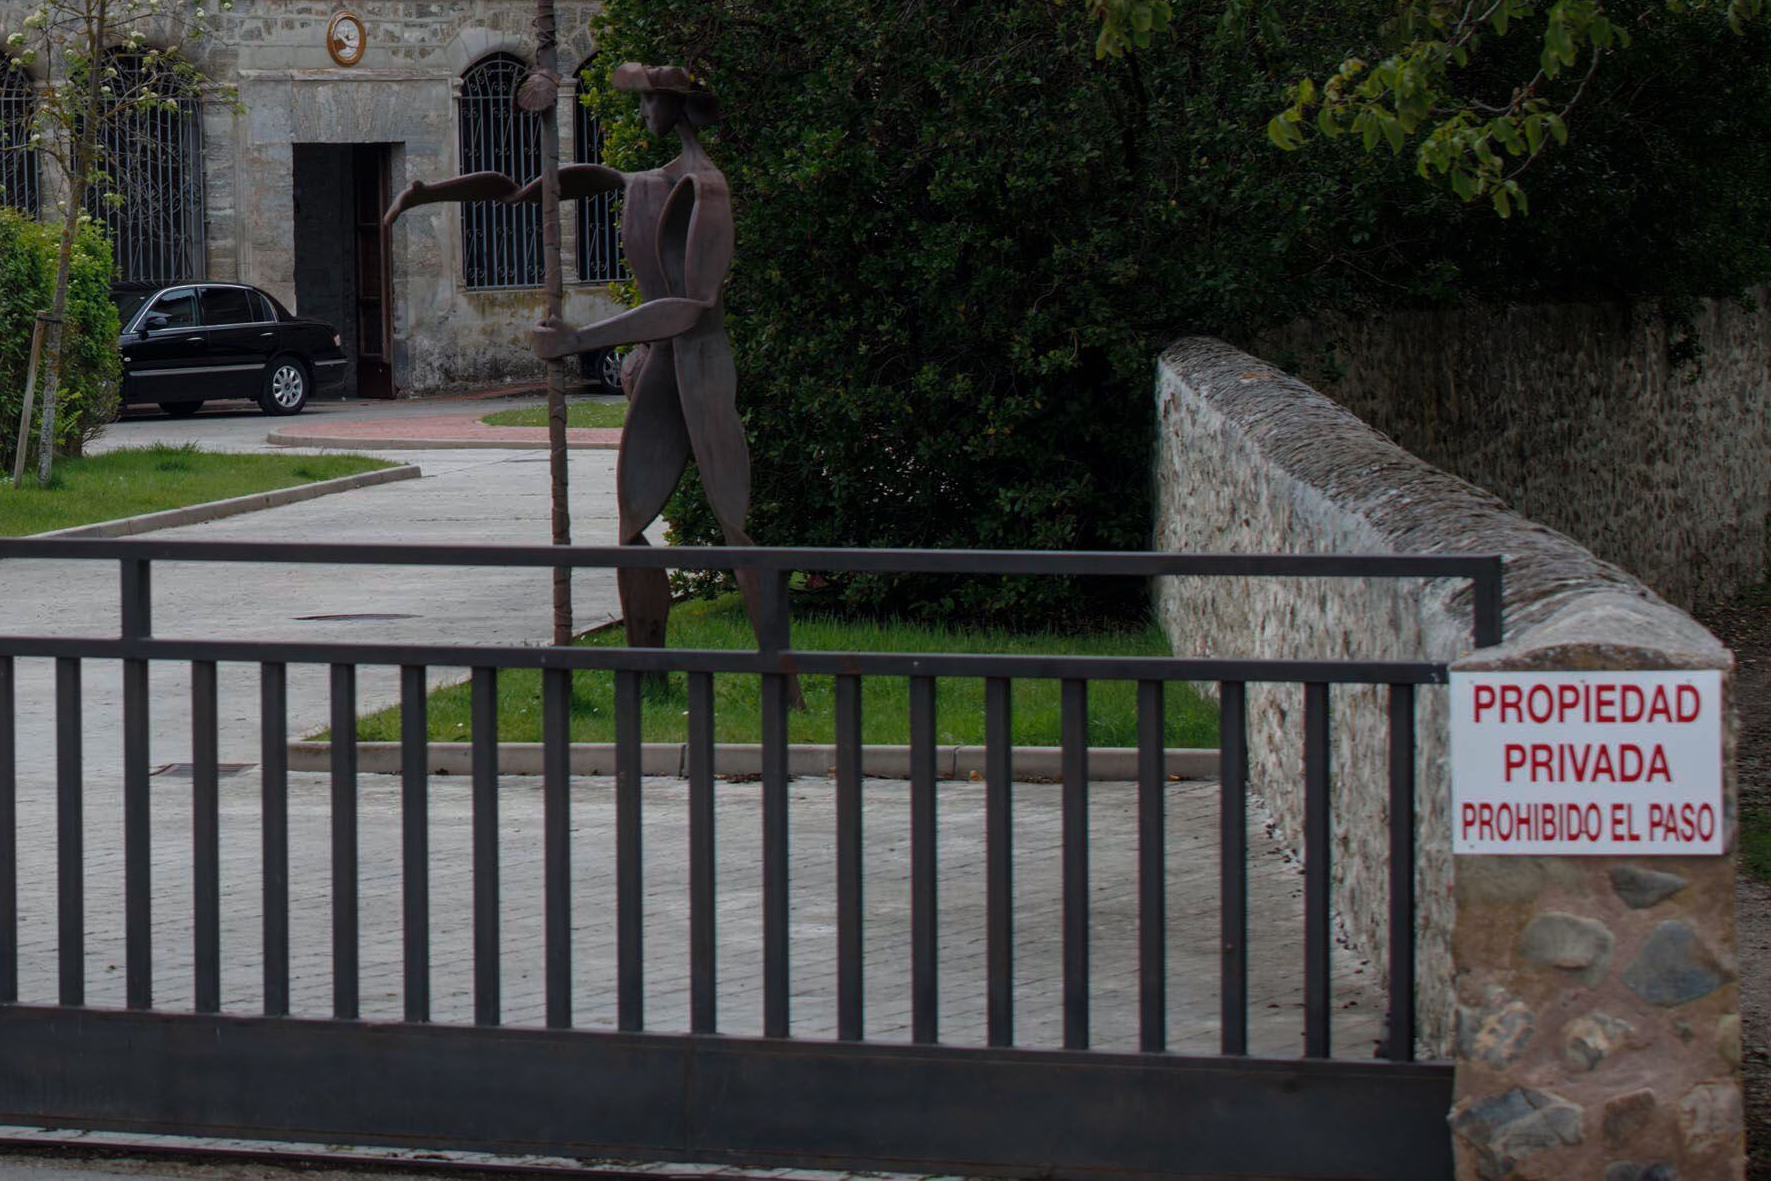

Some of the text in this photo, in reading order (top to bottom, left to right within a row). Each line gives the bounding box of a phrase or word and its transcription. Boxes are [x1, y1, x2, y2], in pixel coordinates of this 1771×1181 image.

[1473, 683, 1701, 724] PROPIEDAD
[1504, 743, 1672, 783] PRIVADA
[1461, 802, 1714, 842] PROHIBIDO EL PASO
